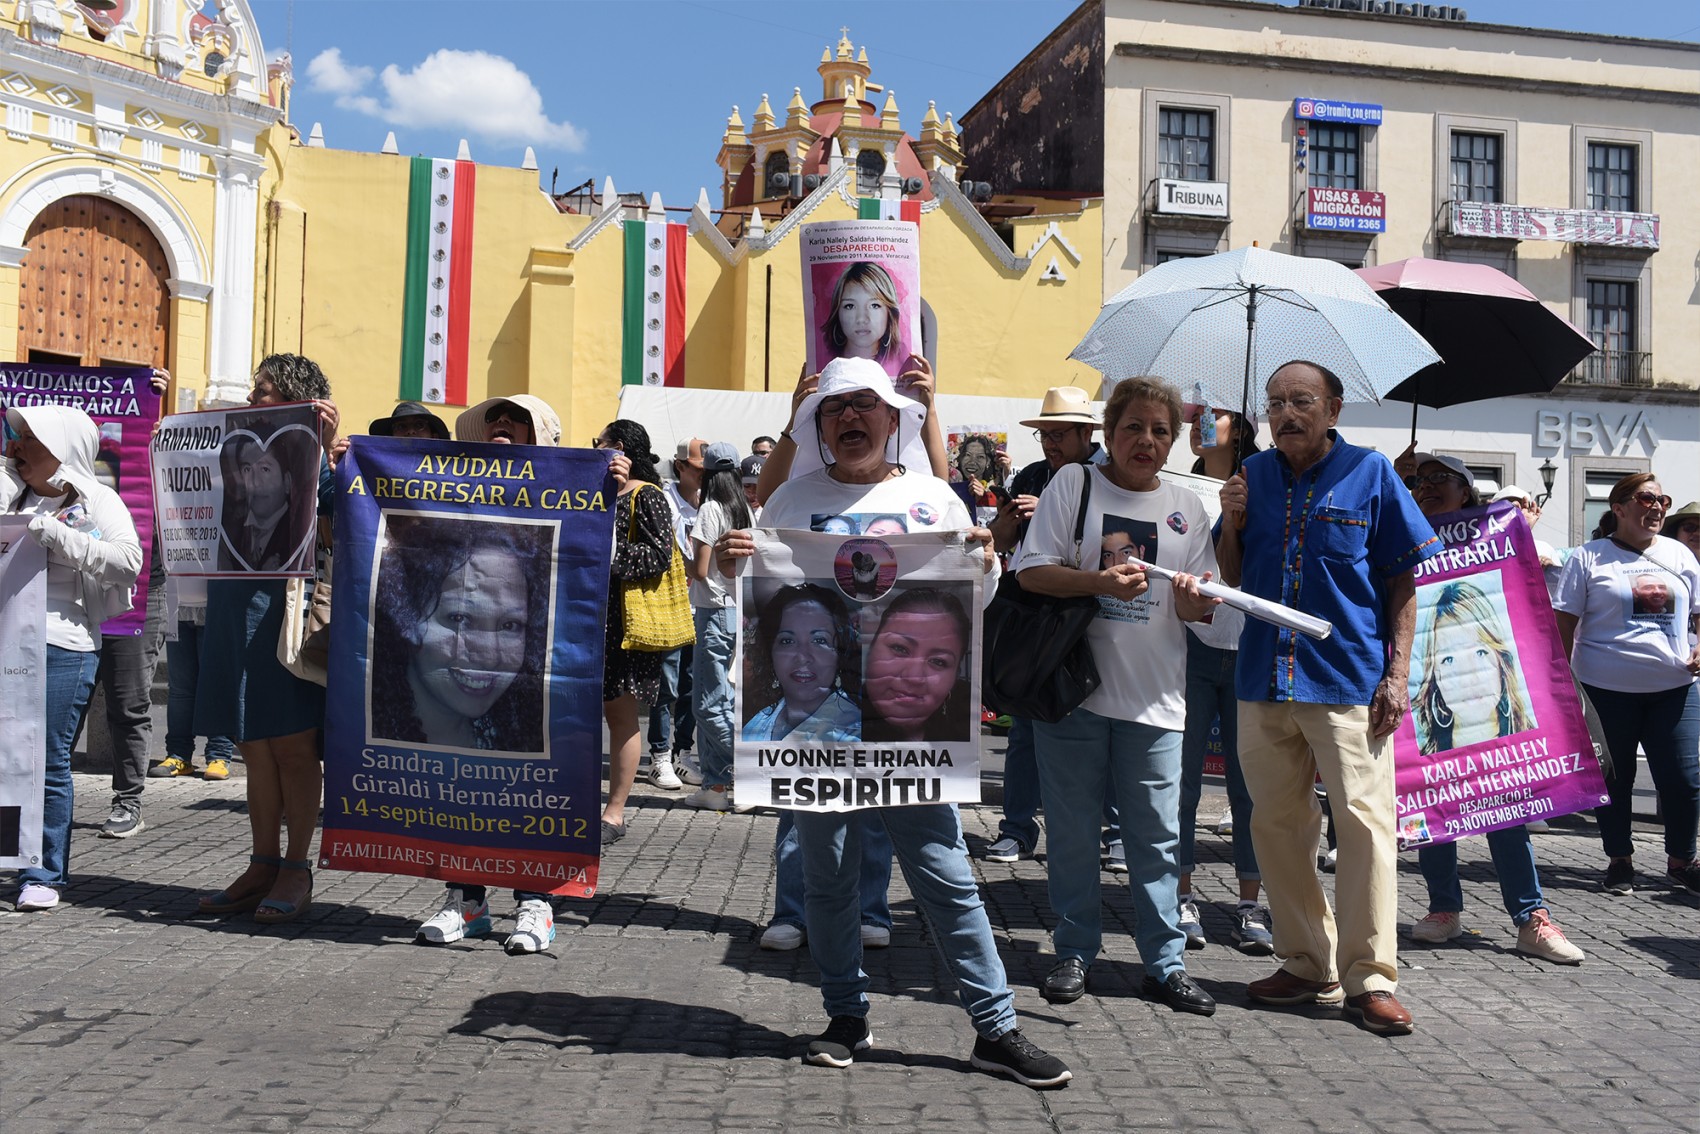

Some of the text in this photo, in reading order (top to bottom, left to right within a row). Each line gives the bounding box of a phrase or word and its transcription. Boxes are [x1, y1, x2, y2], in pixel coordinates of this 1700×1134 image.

[1164, 183, 1223, 206] TRIBUNA
[1313, 189, 1360, 204] VISAS &
[1313, 201, 1382, 217] MIGRACIÓN
[1313, 215, 1381, 230] (228) 501 2365
[823, 244, 896, 253] DESAPARECIDA
[826, 236, 848, 244] Nallely
[849, 235, 876, 243] Saldaña
[876, 235, 909, 244] Hernández
[817, 253, 848, 261] Noviembre
[120, 377, 135, 395] A
[0, 391, 141, 416] NCONTRARLA
[154, 425, 221, 452] ARMANDO
[1536, 410, 1660, 451] BBVA
[415, 453, 535, 480] AYÚDALA
[347, 475, 607, 512] A REGRESAR A CASA
[180, 507, 193, 520] VEZ
[194, 507, 214, 520] VISTO
[1488, 514, 1505, 535] A
[199, 527, 218, 541] 2013
[4, 666, 28, 675] lacio
[361, 748, 559, 786] Sandra Jennyfer
[758, 748, 953, 768] IVONNE E IRIANA
[1421, 737, 1550, 785] KARLA NALLELY
[351, 773, 572, 811] Giraldi Hernández
[771, 769, 941, 806] ESPIRÍTU
[1396, 752, 1585, 815] SALDAÑA HERNÁNDEZ
[1459, 787, 1534, 815] DESAPARECIÓ EL
[340, 796, 588, 839] 14-septiembre-2012
[1445, 797, 1555, 836] 29-NOVIEMBRE-2011
[331, 841, 588, 884] FAMILIARES ENLACES XALAPA
